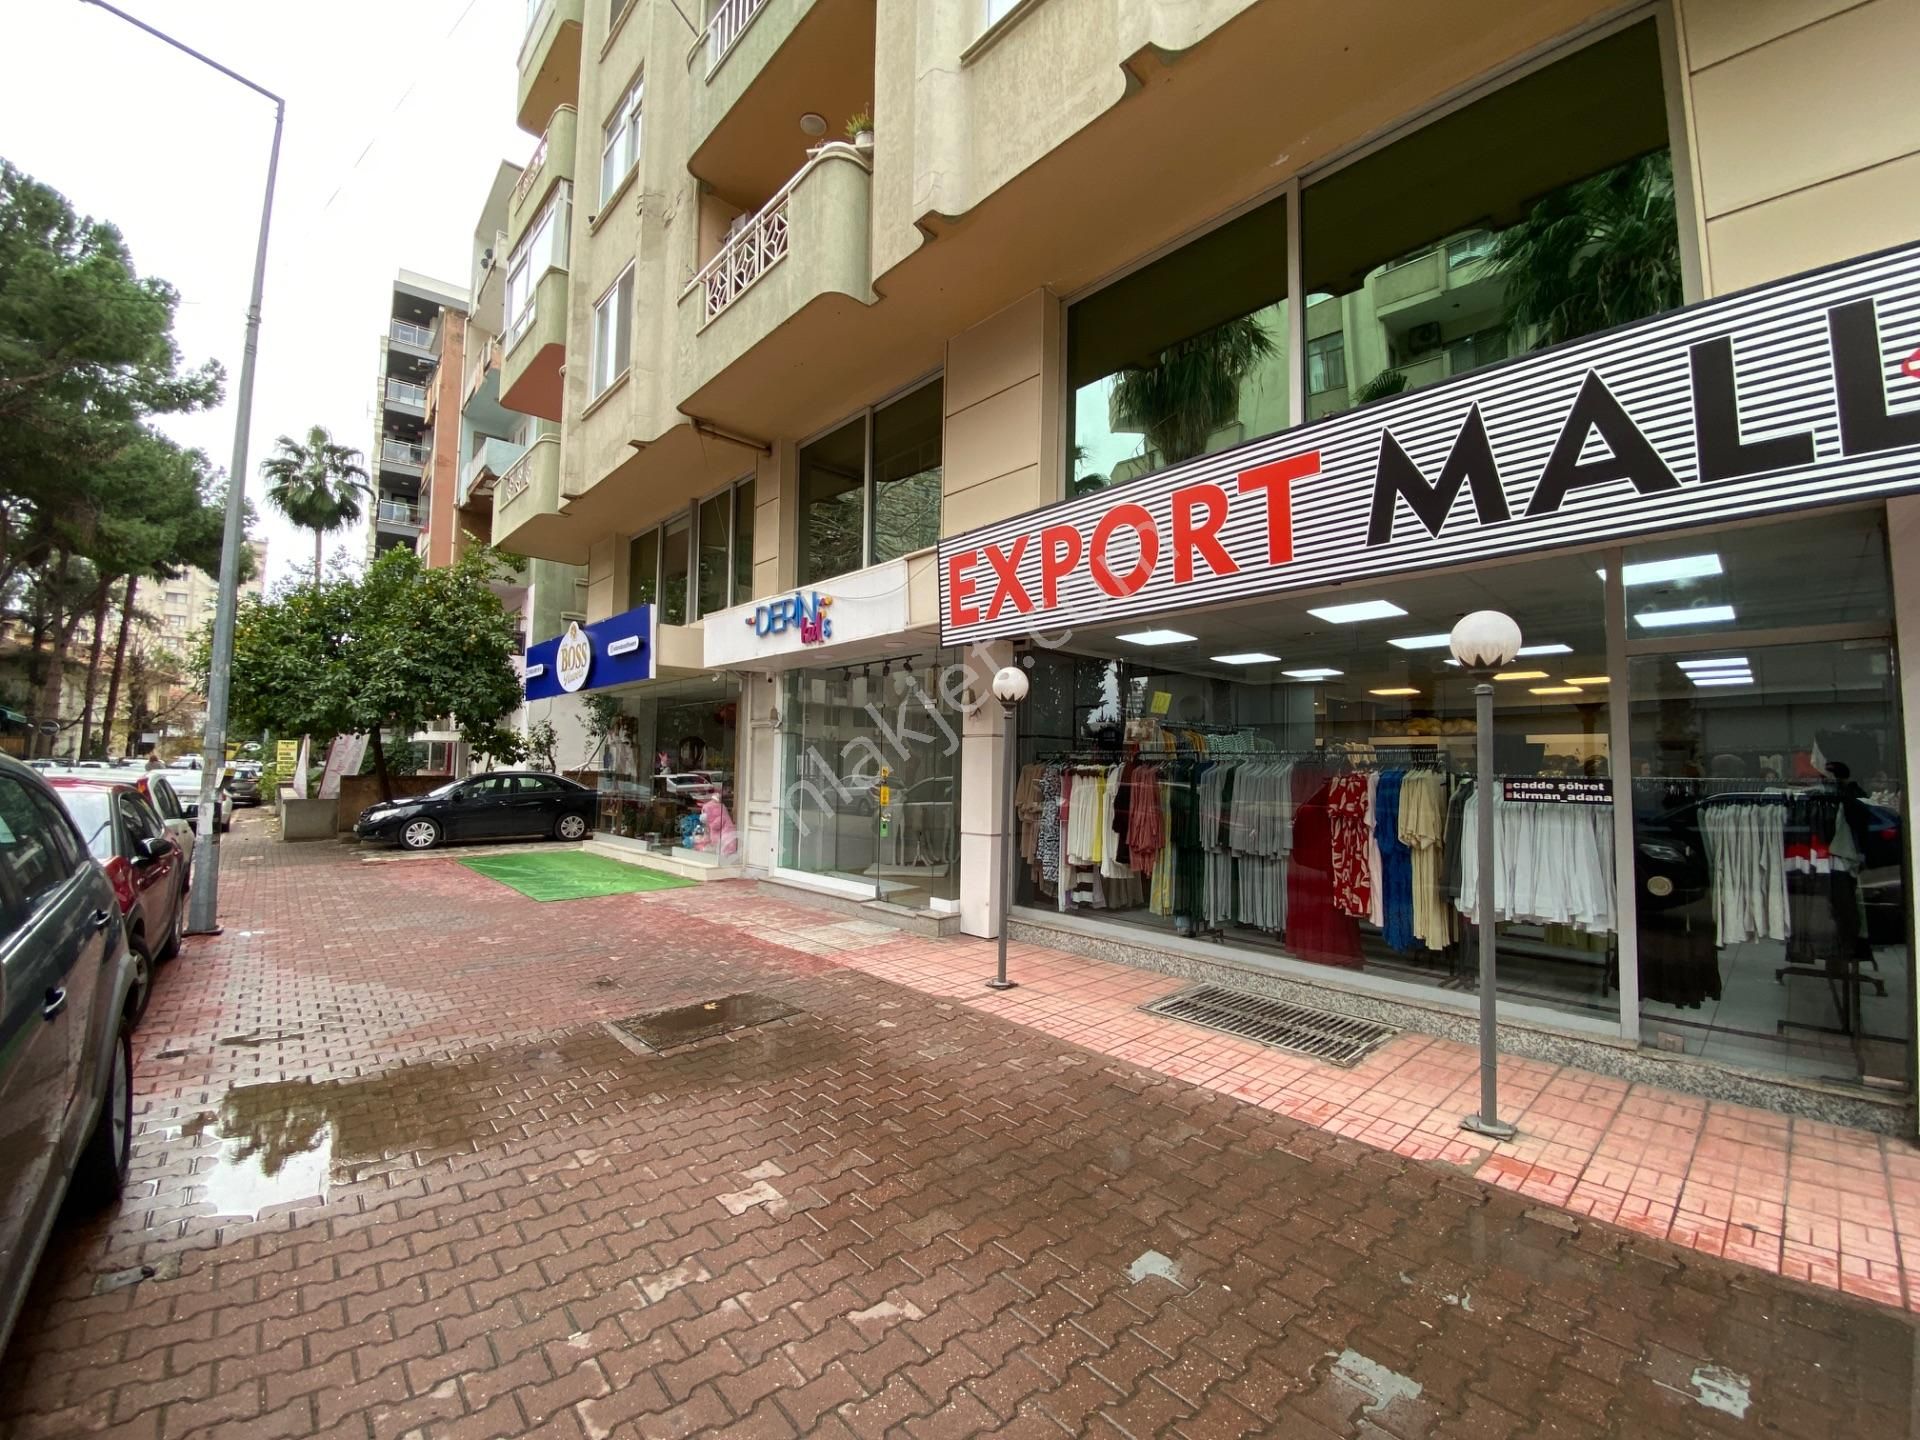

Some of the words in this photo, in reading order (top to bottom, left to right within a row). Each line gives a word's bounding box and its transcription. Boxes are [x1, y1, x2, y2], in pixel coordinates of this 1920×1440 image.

[949, 451, 1322, 628] EXPORT
[1366, 298, 1920, 547] MALL
[561, 642, 587, 672] BOSS
[1513, 781, 1554, 789] cadde
[1558, 782, 1605, 792] şöhret
[1513, 791, 1613, 802] kirman_adana
